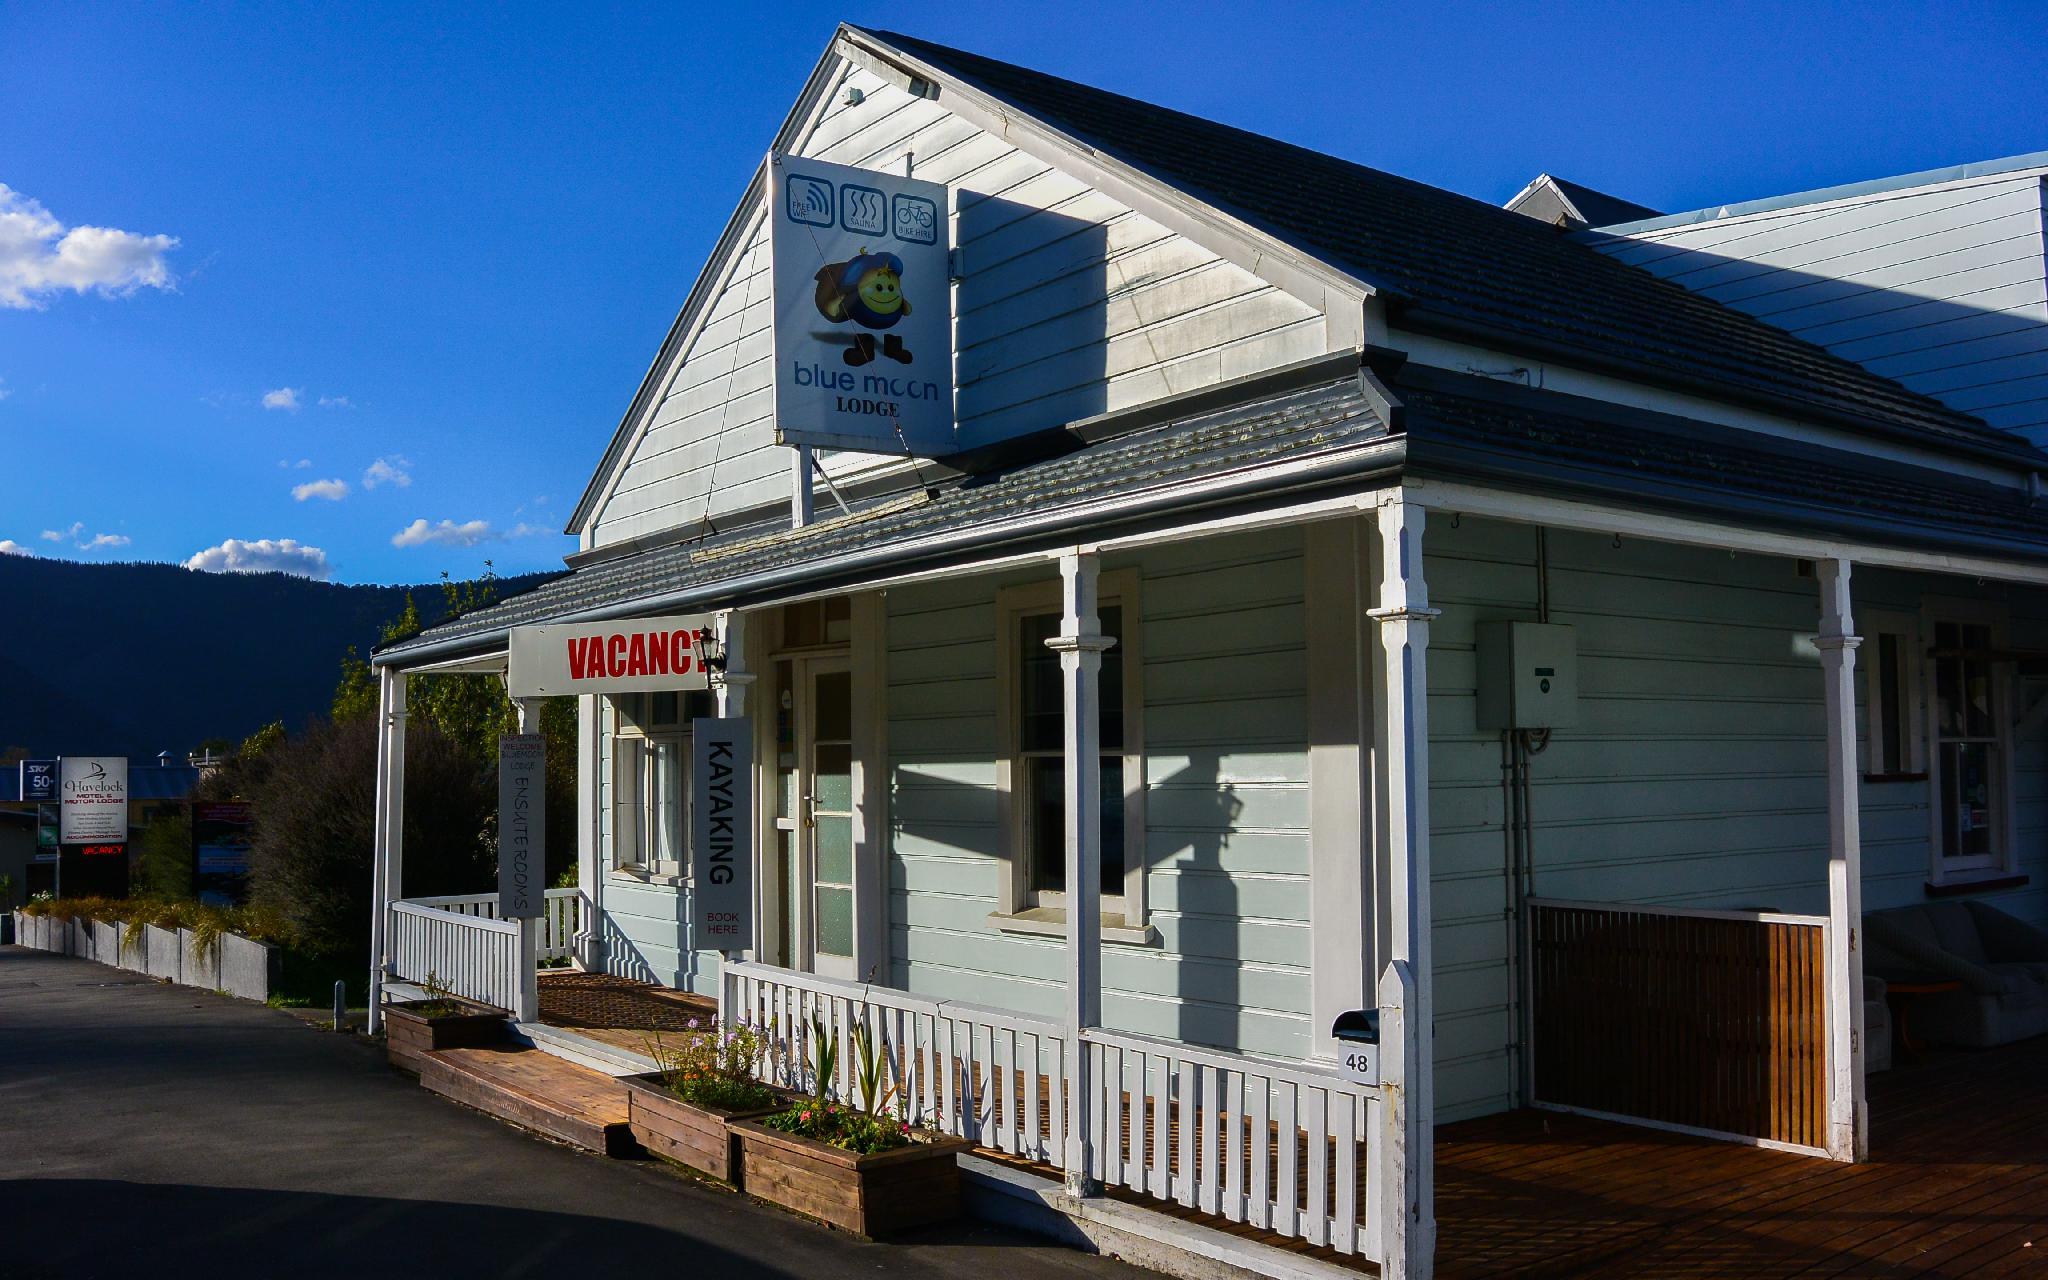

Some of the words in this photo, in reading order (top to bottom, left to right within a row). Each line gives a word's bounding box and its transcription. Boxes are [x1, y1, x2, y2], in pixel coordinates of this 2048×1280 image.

[792, 201, 811, 212] FREE
[850, 217, 876, 229] SAUNA
[898, 227, 914, 236] BIKE
[915, 229, 932, 239] HIRE
[794, 361, 855, 391] blue
[835, 396, 900, 418] LODGE
[27, 765, 50, 773] SKY
[64, 780, 124, 792] Havelock
[709, 741, 734, 885] KAYAKING
[82, 846, 123, 855] VACANCY
[514, 848, 529, 910] ROOMS
[707, 912, 739, 923] BOOK
[708, 925, 739, 935] HERE
[1346, 1053, 1368, 1073] 48
